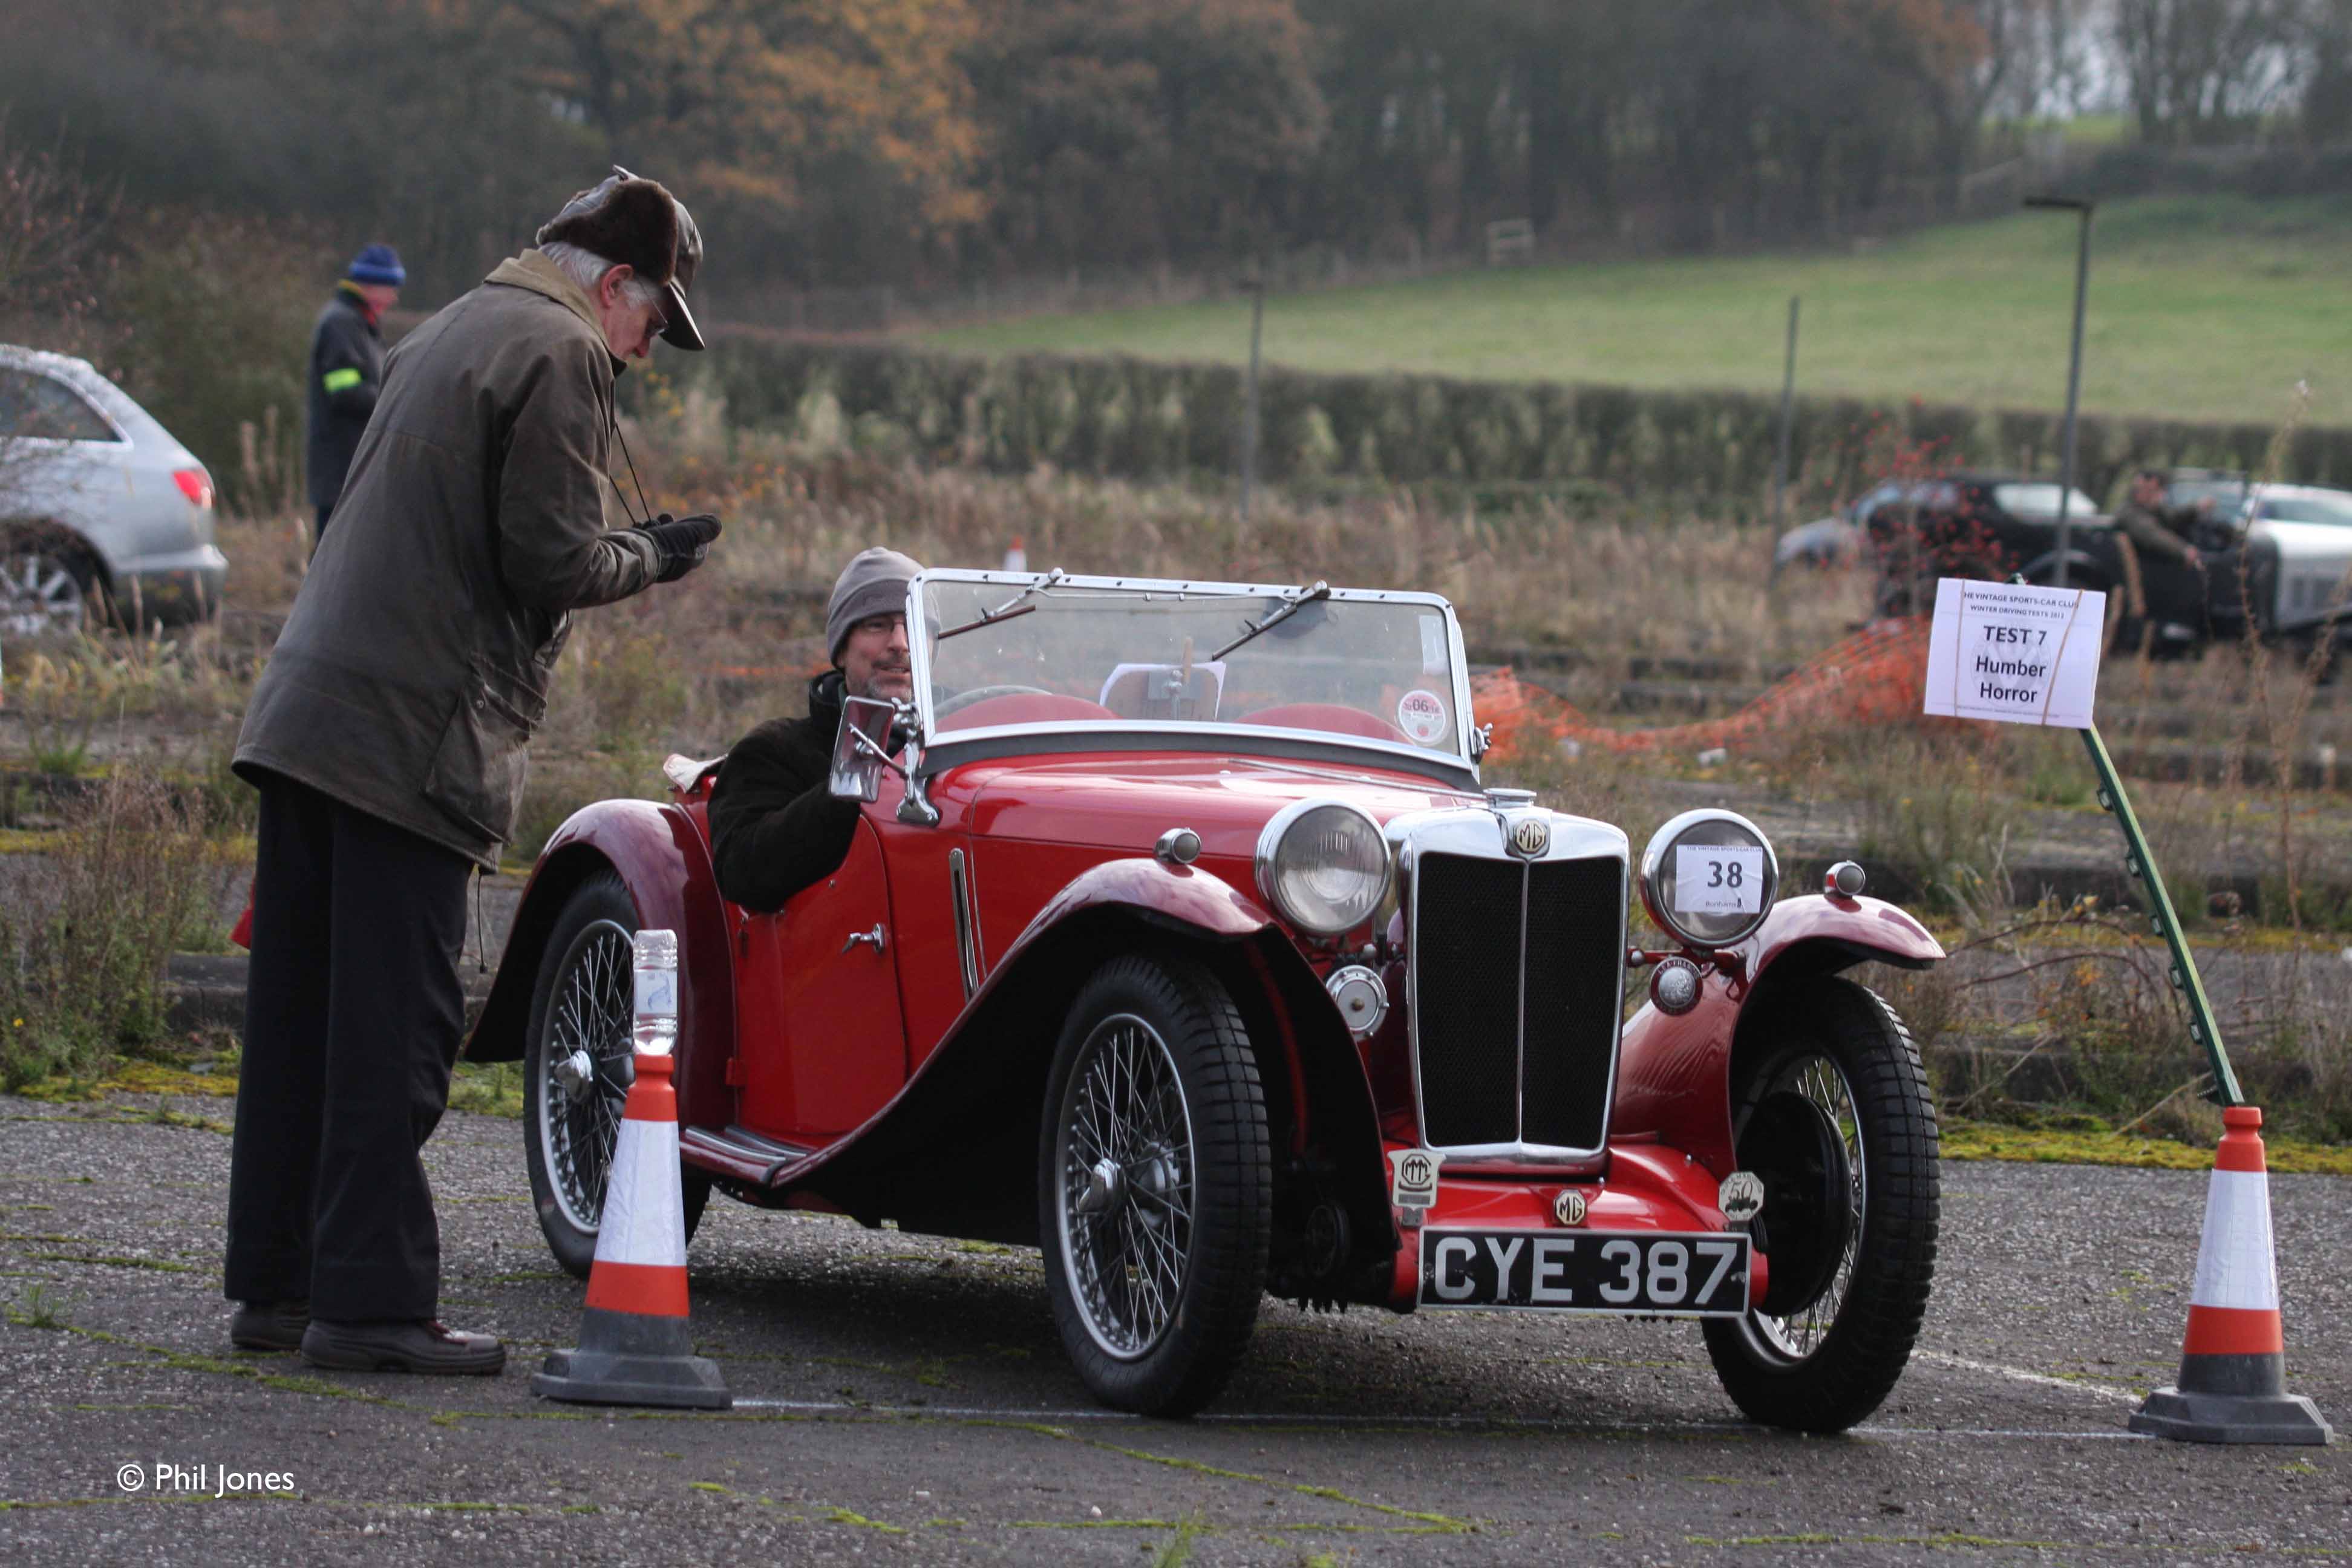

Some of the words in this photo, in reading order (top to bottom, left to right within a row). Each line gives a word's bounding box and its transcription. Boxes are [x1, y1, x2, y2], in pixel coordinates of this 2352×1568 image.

[1970, 604, 1997, 612] WINTER
[1999, 606, 2027, 615] DRIVING
[2028, 610, 2048, 618] TESTS
[1975, 593, 2008, 602] VINTAGE
[2010, 595, 2056, 606] SPORTS-CAR
[1983, 625, 2032, 644] TEST
[2037, 630, 2047, 645] 7
[1976, 655, 2047, 678] Humber
[1979, 682, 2038, 703] Horror
[1518, 822, 1543, 849] MG
[1707, 861, 1742, 888] 38
[1559, 1196, 1583, 1222] MG
[1434, 1236, 1575, 1302] CYE
[1599, 1238, 1738, 1305] 387
